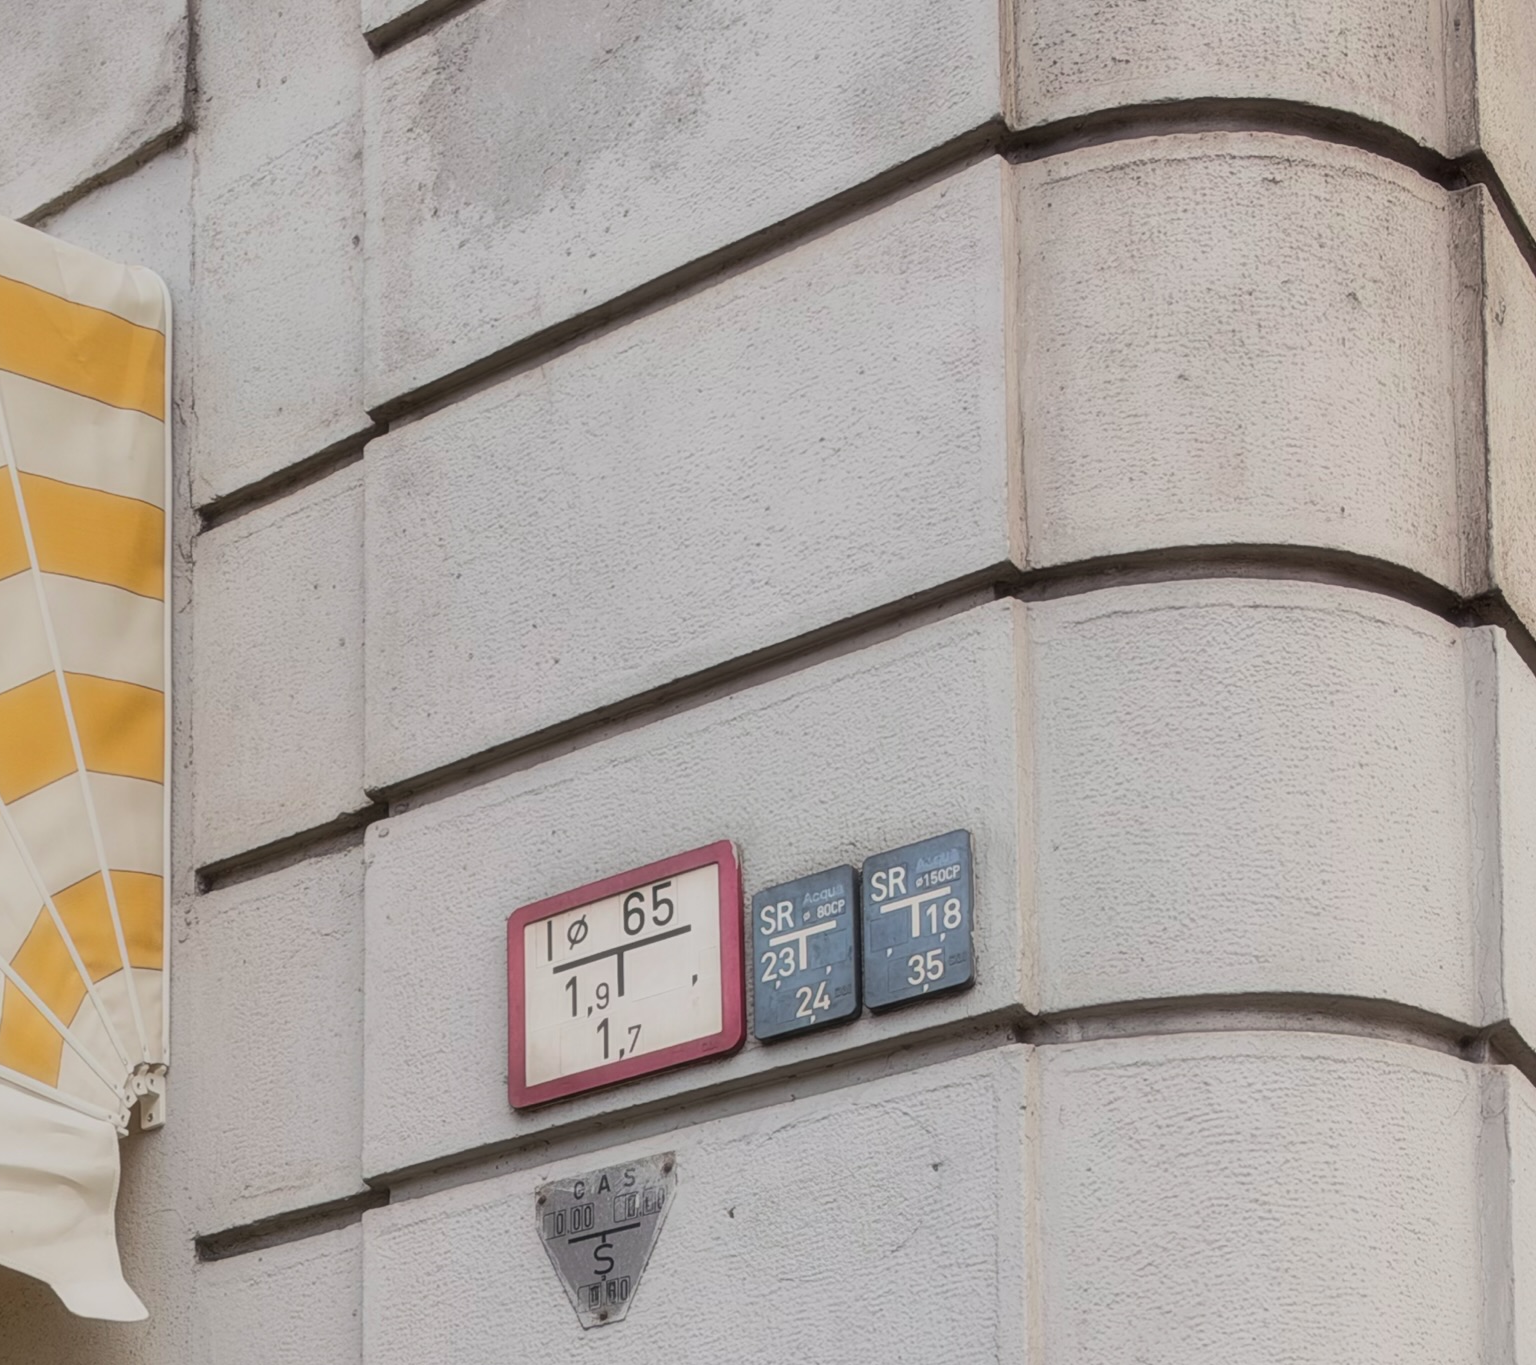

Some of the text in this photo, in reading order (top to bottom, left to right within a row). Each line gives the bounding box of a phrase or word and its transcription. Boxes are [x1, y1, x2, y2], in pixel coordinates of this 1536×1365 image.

[915, 849, 960, 872] Acqua
[802, 884, 844, 905] Acqua
[871, 866, 907, 902] SR
[623, 881, 674, 936] 65
[760, 900, 795, 935] SR
[565, 975, 610, 1018] 1,9
[596, 1017, 642, 1060] 1,7
[594, 1243, 614, 1276] S
